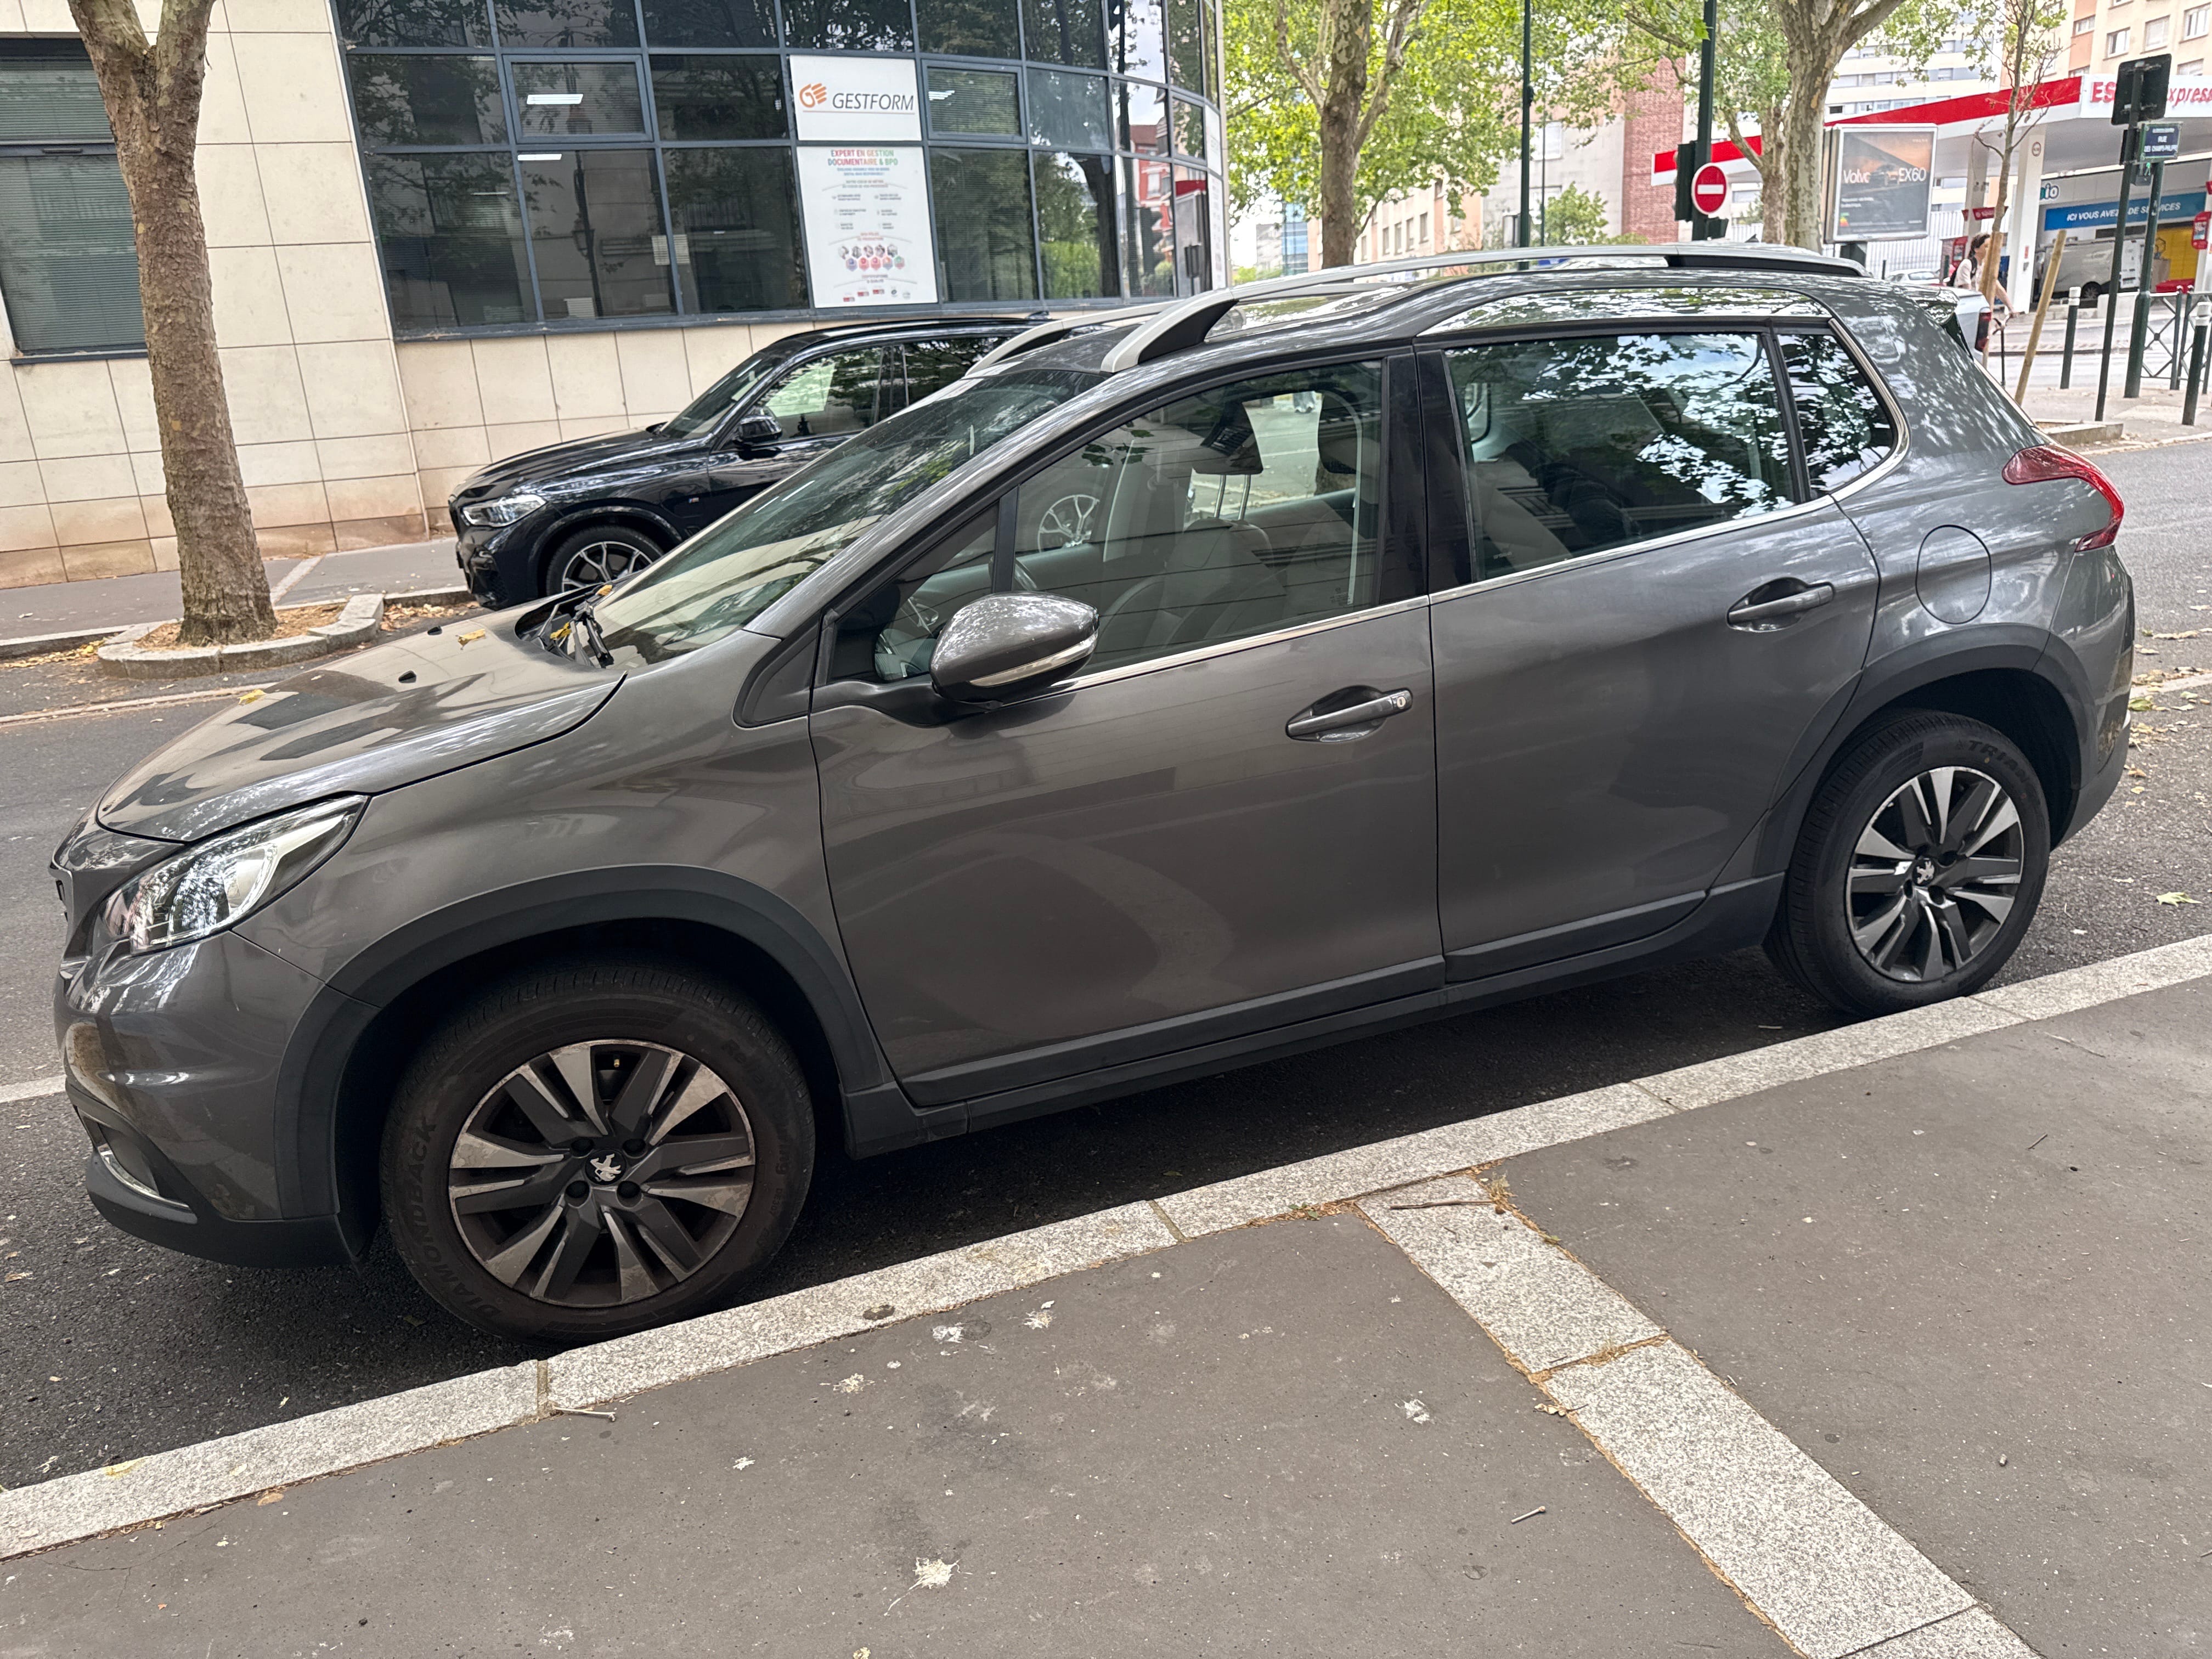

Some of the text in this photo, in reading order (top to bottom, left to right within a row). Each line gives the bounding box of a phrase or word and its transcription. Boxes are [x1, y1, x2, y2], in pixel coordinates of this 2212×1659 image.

[833, 93, 913, 110] GESTFORM
[2167, 88, 2212, 106] xpress
[831, 149, 855, 157] EXPERT
[856, 149, 865, 157] EN
[1898, 167, 1927, 182] EX60
[2067, 213, 2078, 222] ICI
[2078, 211, 2100, 220] VOUS
[2128, 207, 2140, 216] DE
[2141, 202, 2181, 213] SEVICES
[408, 1115, 501, 1317] DIAMONDBACK
